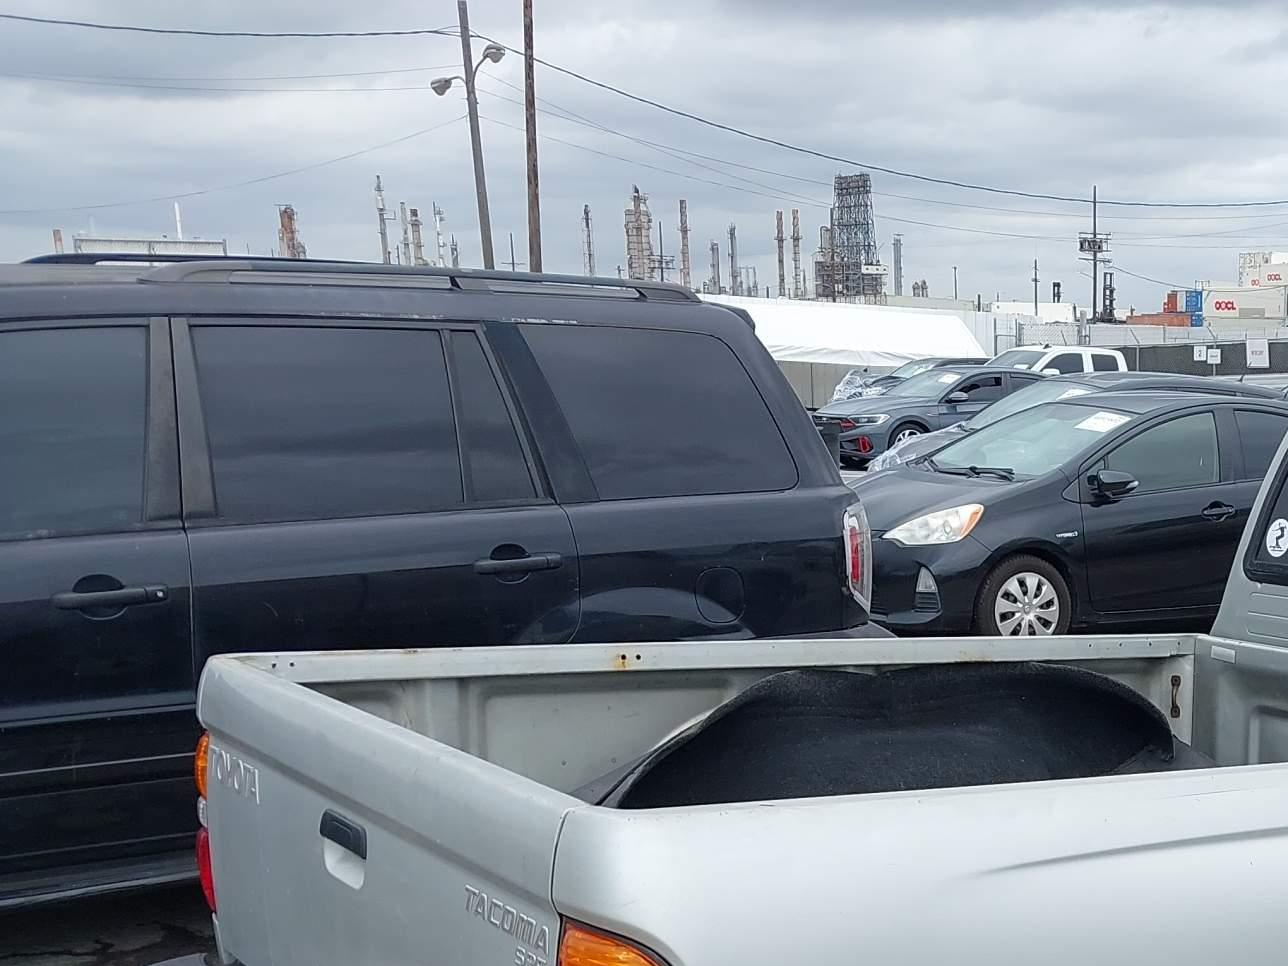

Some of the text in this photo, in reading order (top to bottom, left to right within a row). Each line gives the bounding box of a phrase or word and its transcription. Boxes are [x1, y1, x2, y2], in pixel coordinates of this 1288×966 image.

[1267, 273, 1282, 281] OOCL
[1215, 301, 1236, 310] OOCL
[209, 744, 260, 806] TOYOTA
[464, 884, 549, 956] TACOMA
